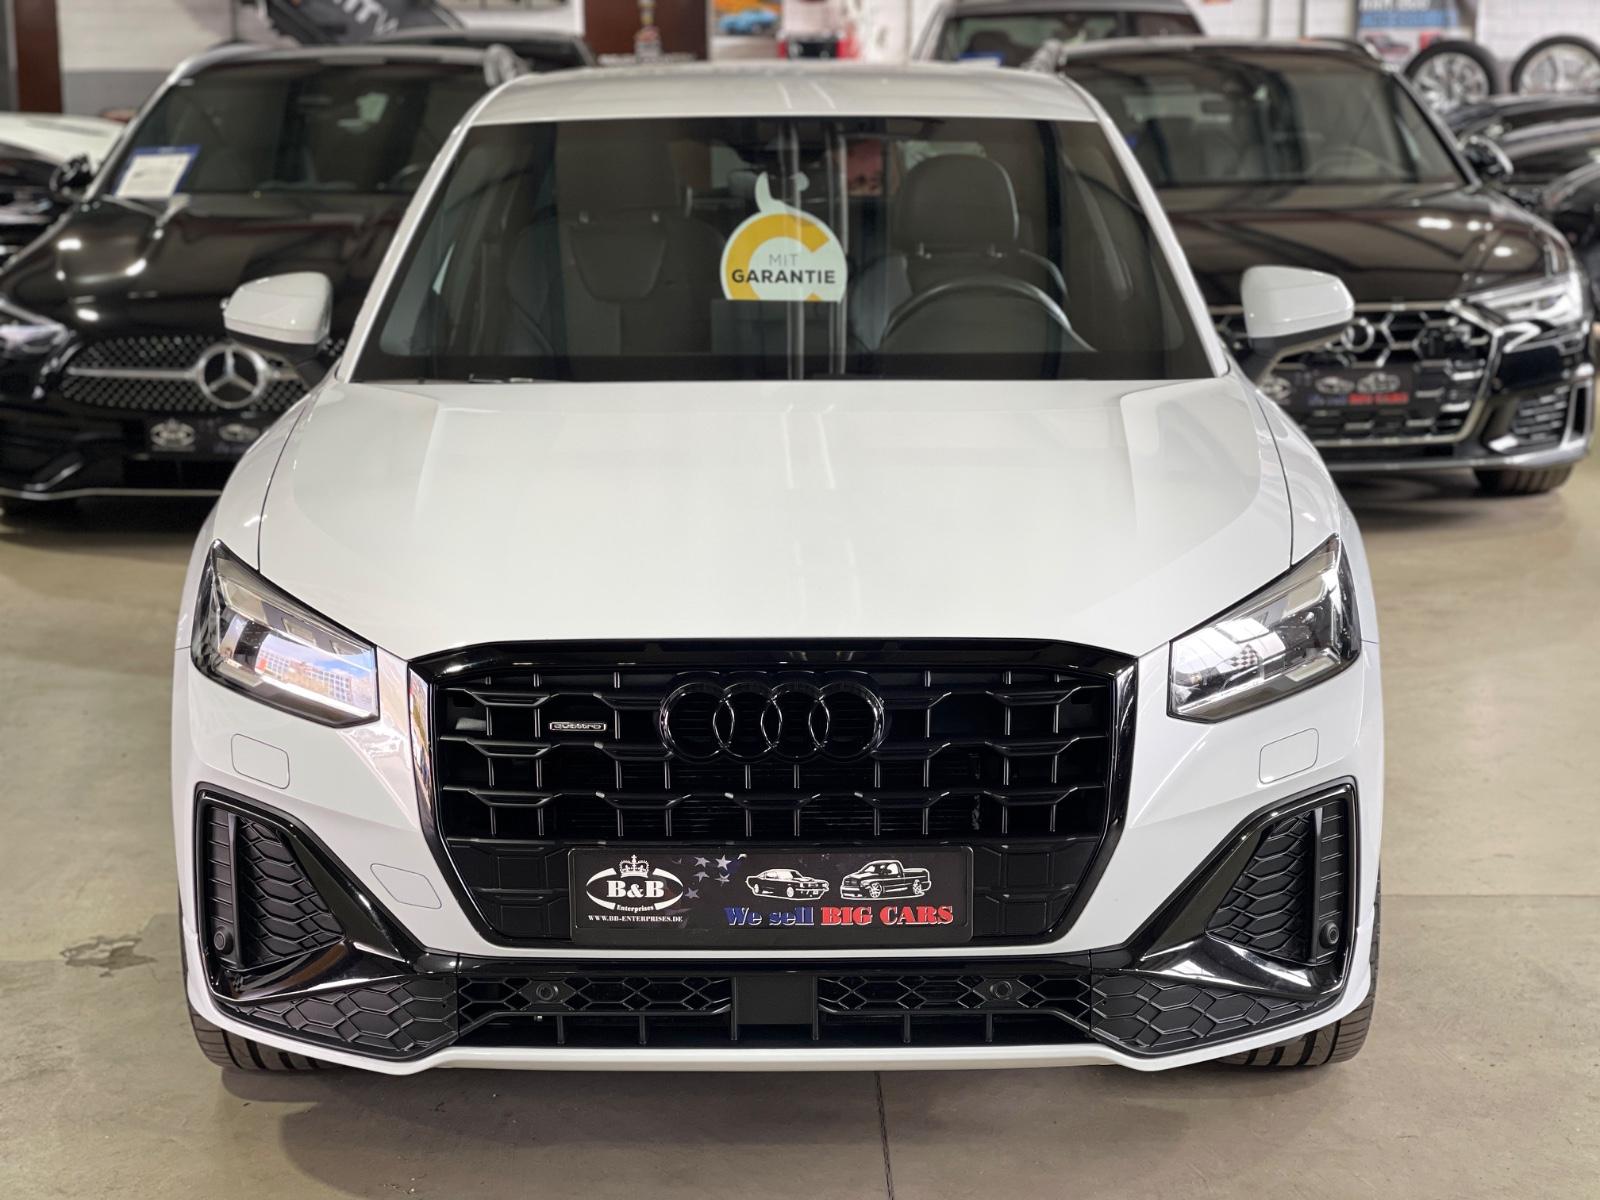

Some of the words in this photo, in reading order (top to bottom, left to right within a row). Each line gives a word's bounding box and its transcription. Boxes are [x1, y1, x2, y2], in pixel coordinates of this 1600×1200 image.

[768, 253, 799, 267] MIT
[731, 269, 836, 285] GARANTIE
[606, 880, 665, 898] B&B
[616, 904, 655, 914] Enterprises
[724, 907, 763, 926] We
[769, 907, 815, 926] sell
[820, 907, 874, 926] BIG
[879, 906, 955, 926] CARS
[588, 915, 684, 923] WWW.BB-ENTERPRISES.DE
